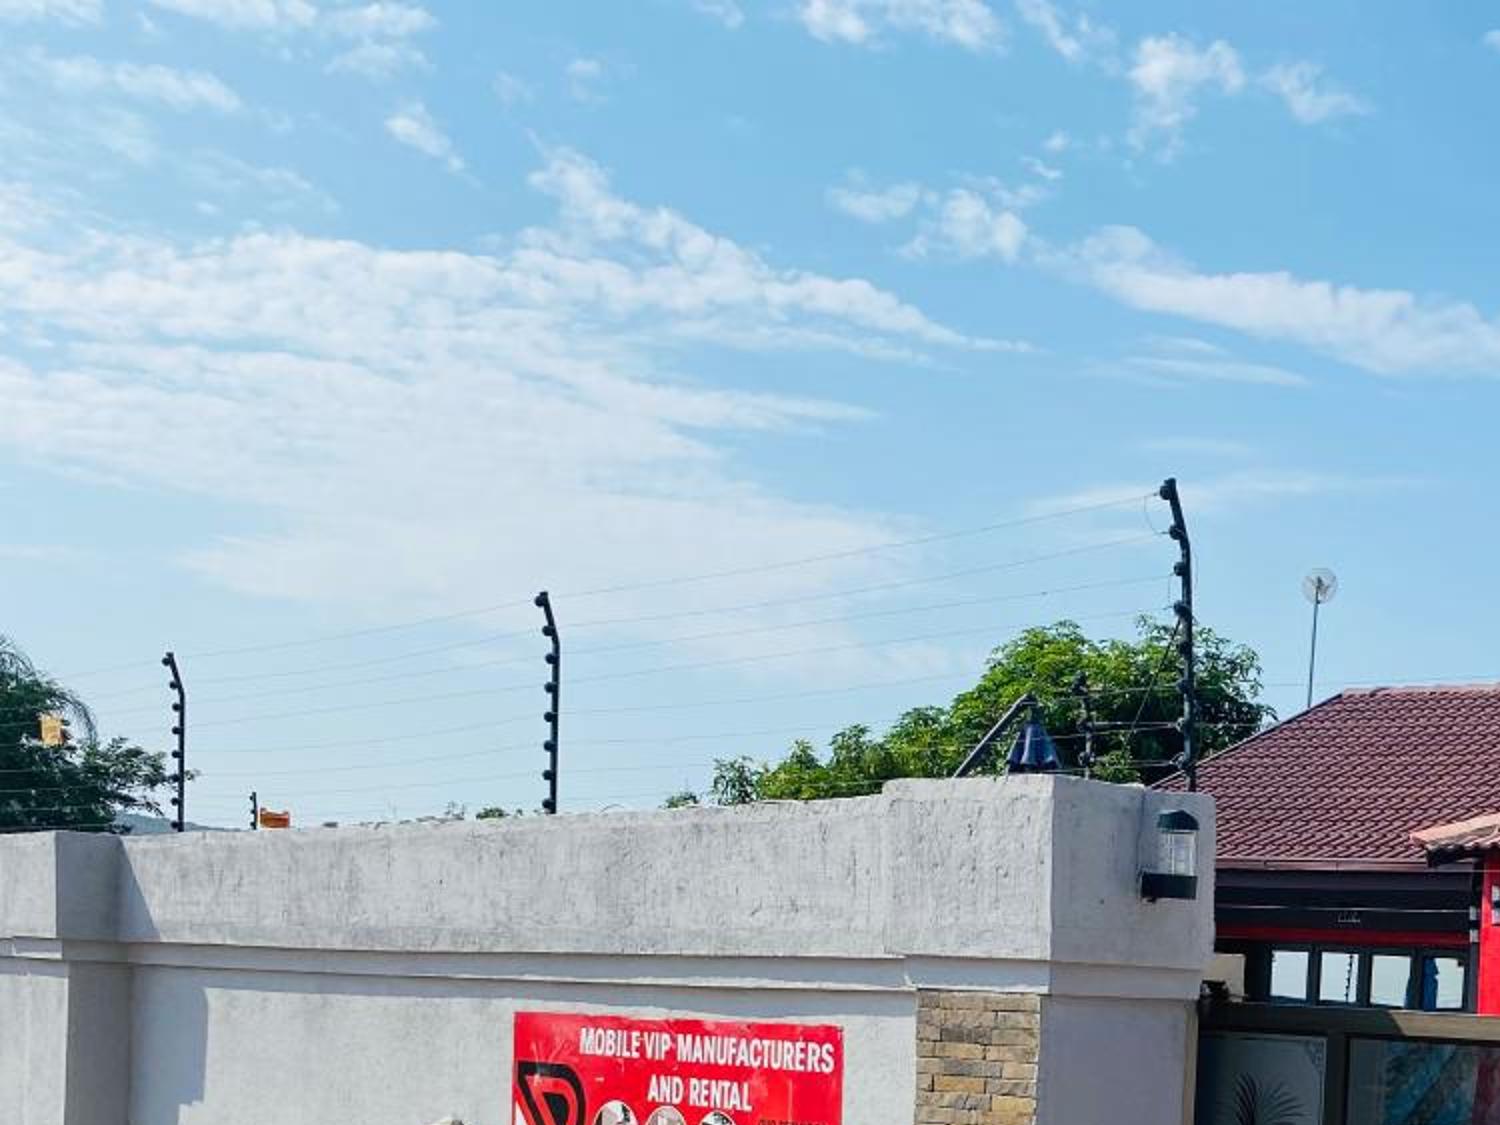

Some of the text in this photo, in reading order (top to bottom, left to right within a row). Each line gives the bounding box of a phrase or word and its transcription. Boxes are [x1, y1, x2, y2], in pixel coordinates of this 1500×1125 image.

[580, 1027, 835, 1074] MOBILE VIP MANUFACTURERS
[647, 1074, 753, 1112] AND RENTAL
